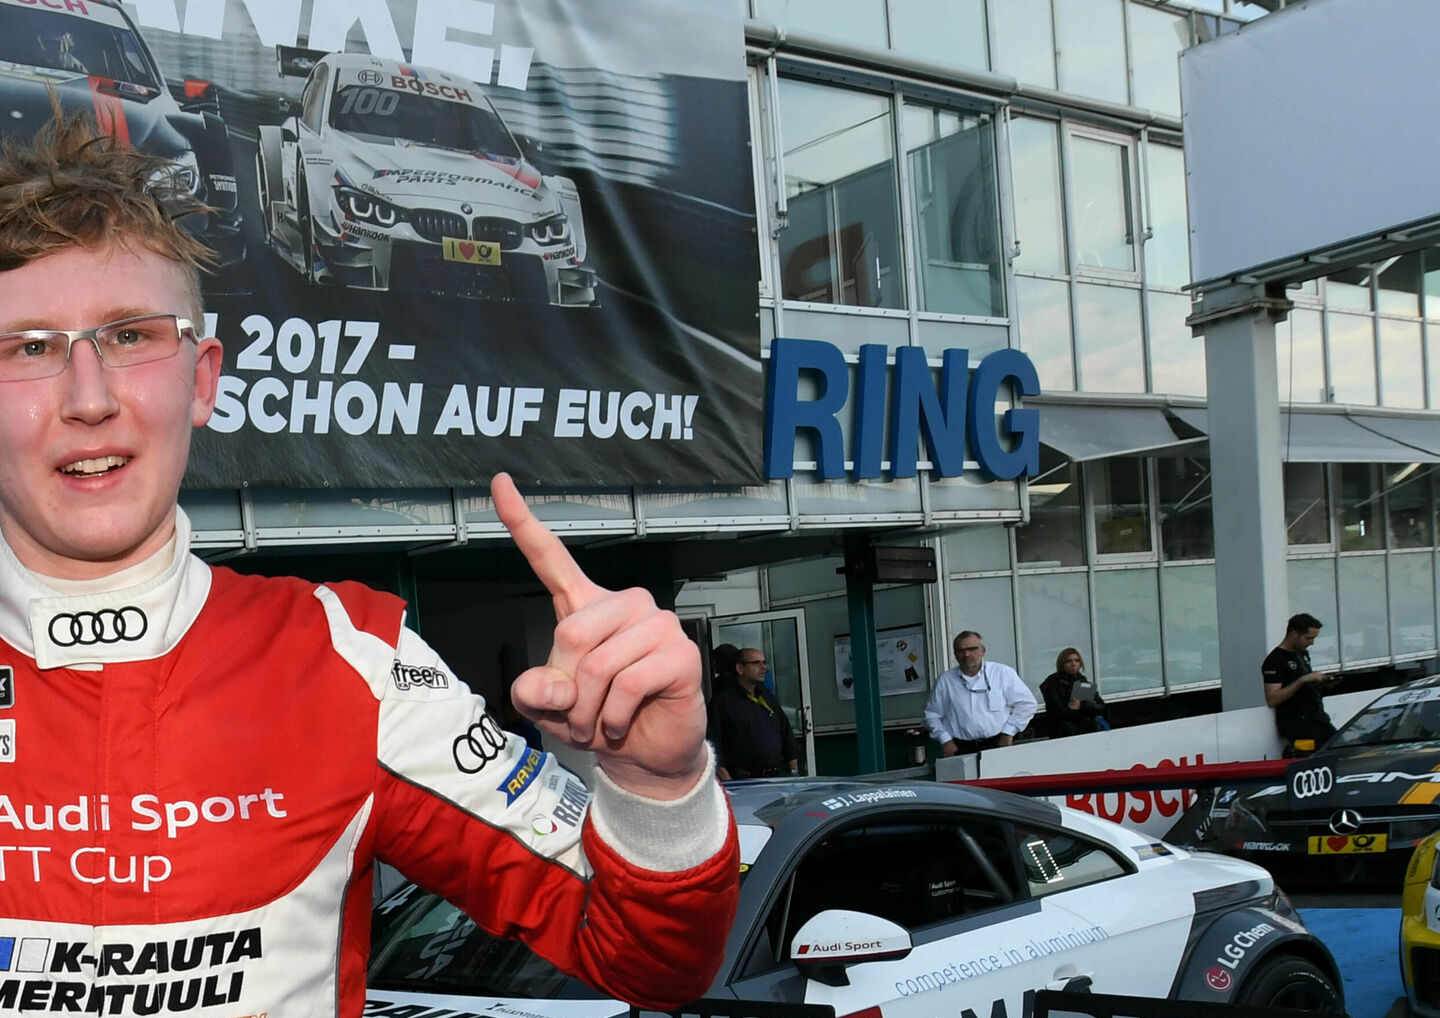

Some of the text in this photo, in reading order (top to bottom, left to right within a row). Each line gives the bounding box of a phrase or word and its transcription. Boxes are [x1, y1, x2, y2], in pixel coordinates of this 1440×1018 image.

[340, 88, 400, 116] 100
[391, 76, 473, 103] BOSCH
[396, 175, 458, 187] PARTS
[236, 314, 380, 375] 2017
[205, 376, 423, 436] SCHON
[433, 383, 544, 437] AUF
[553, 389, 699, 441] EUCH!
[763, 337, 1042, 482] RING
[131, 787, 288, 839] Sport
[849, 788, 917, 804] Lappalainen
[70, 846, 173, 893] Cup
[50, 927, 264, 977] K-RAUTA
[812, 940, 882, 952] Audi Sport
[895, 923, 1110, 998] competence in aluminium
[1217, 923, 1275, 970] LG Chem
